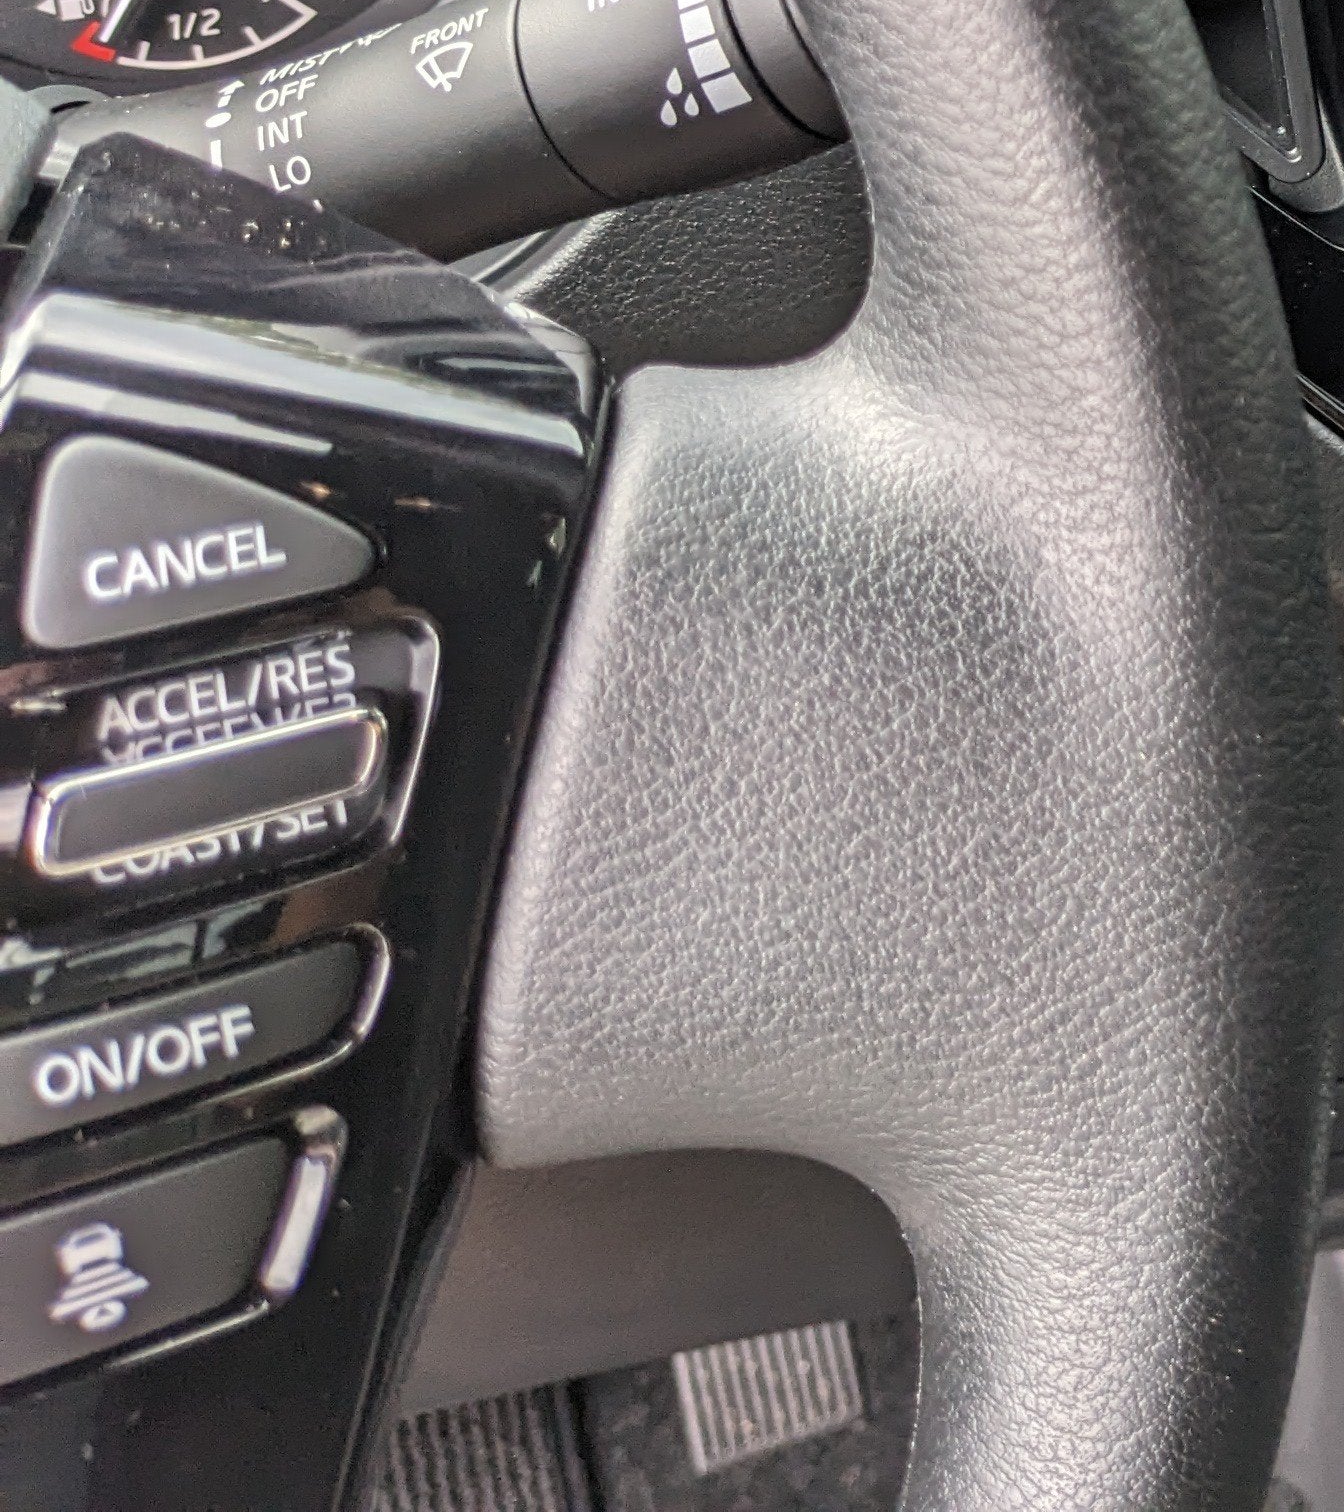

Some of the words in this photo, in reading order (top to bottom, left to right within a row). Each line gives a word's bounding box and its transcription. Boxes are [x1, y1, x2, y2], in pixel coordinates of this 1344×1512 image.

[167, 7, 221, 41] 1/2
[409, 7, 489, 55] FRONT
[260, 47, 341, 85] MIST
[255, 74, 319, 113] OFF
[257, 110, 308, 151] INT
[268, 155, 312, 193] LO
[84, 522, 287, 603] CANCEL
[97, 644, 357, 742] ACCEL/RES
[33, 1004, 257, 1106] ON/OFF
